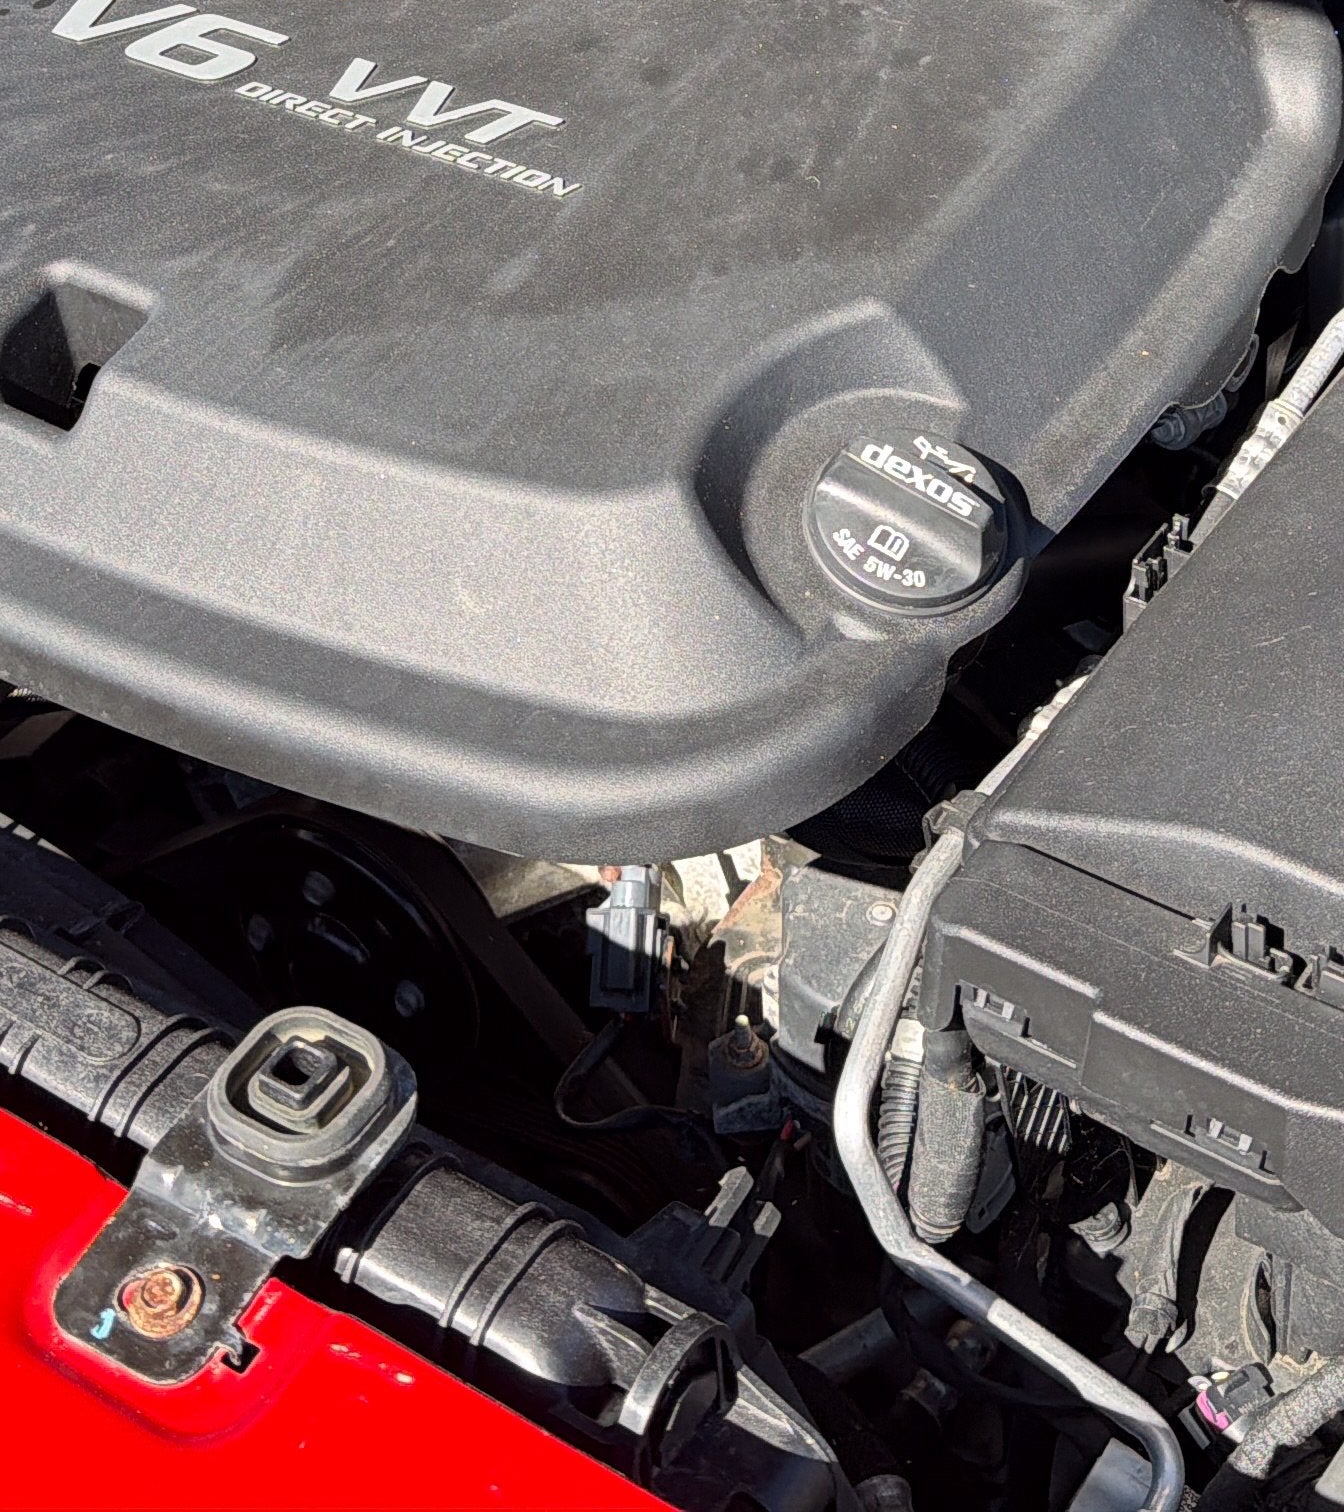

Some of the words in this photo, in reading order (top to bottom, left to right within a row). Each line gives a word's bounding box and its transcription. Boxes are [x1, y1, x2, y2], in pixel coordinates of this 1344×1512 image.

[234, 80, 378, 132] DIRECT
[375, 125, 582, 199] INJECTION
[329, 57, 566, 146] VVT
[859, 443, 980, 517] dexos
[833, 528, 866, 561] SAE
[863, 555, 926, 589] 5W-30
